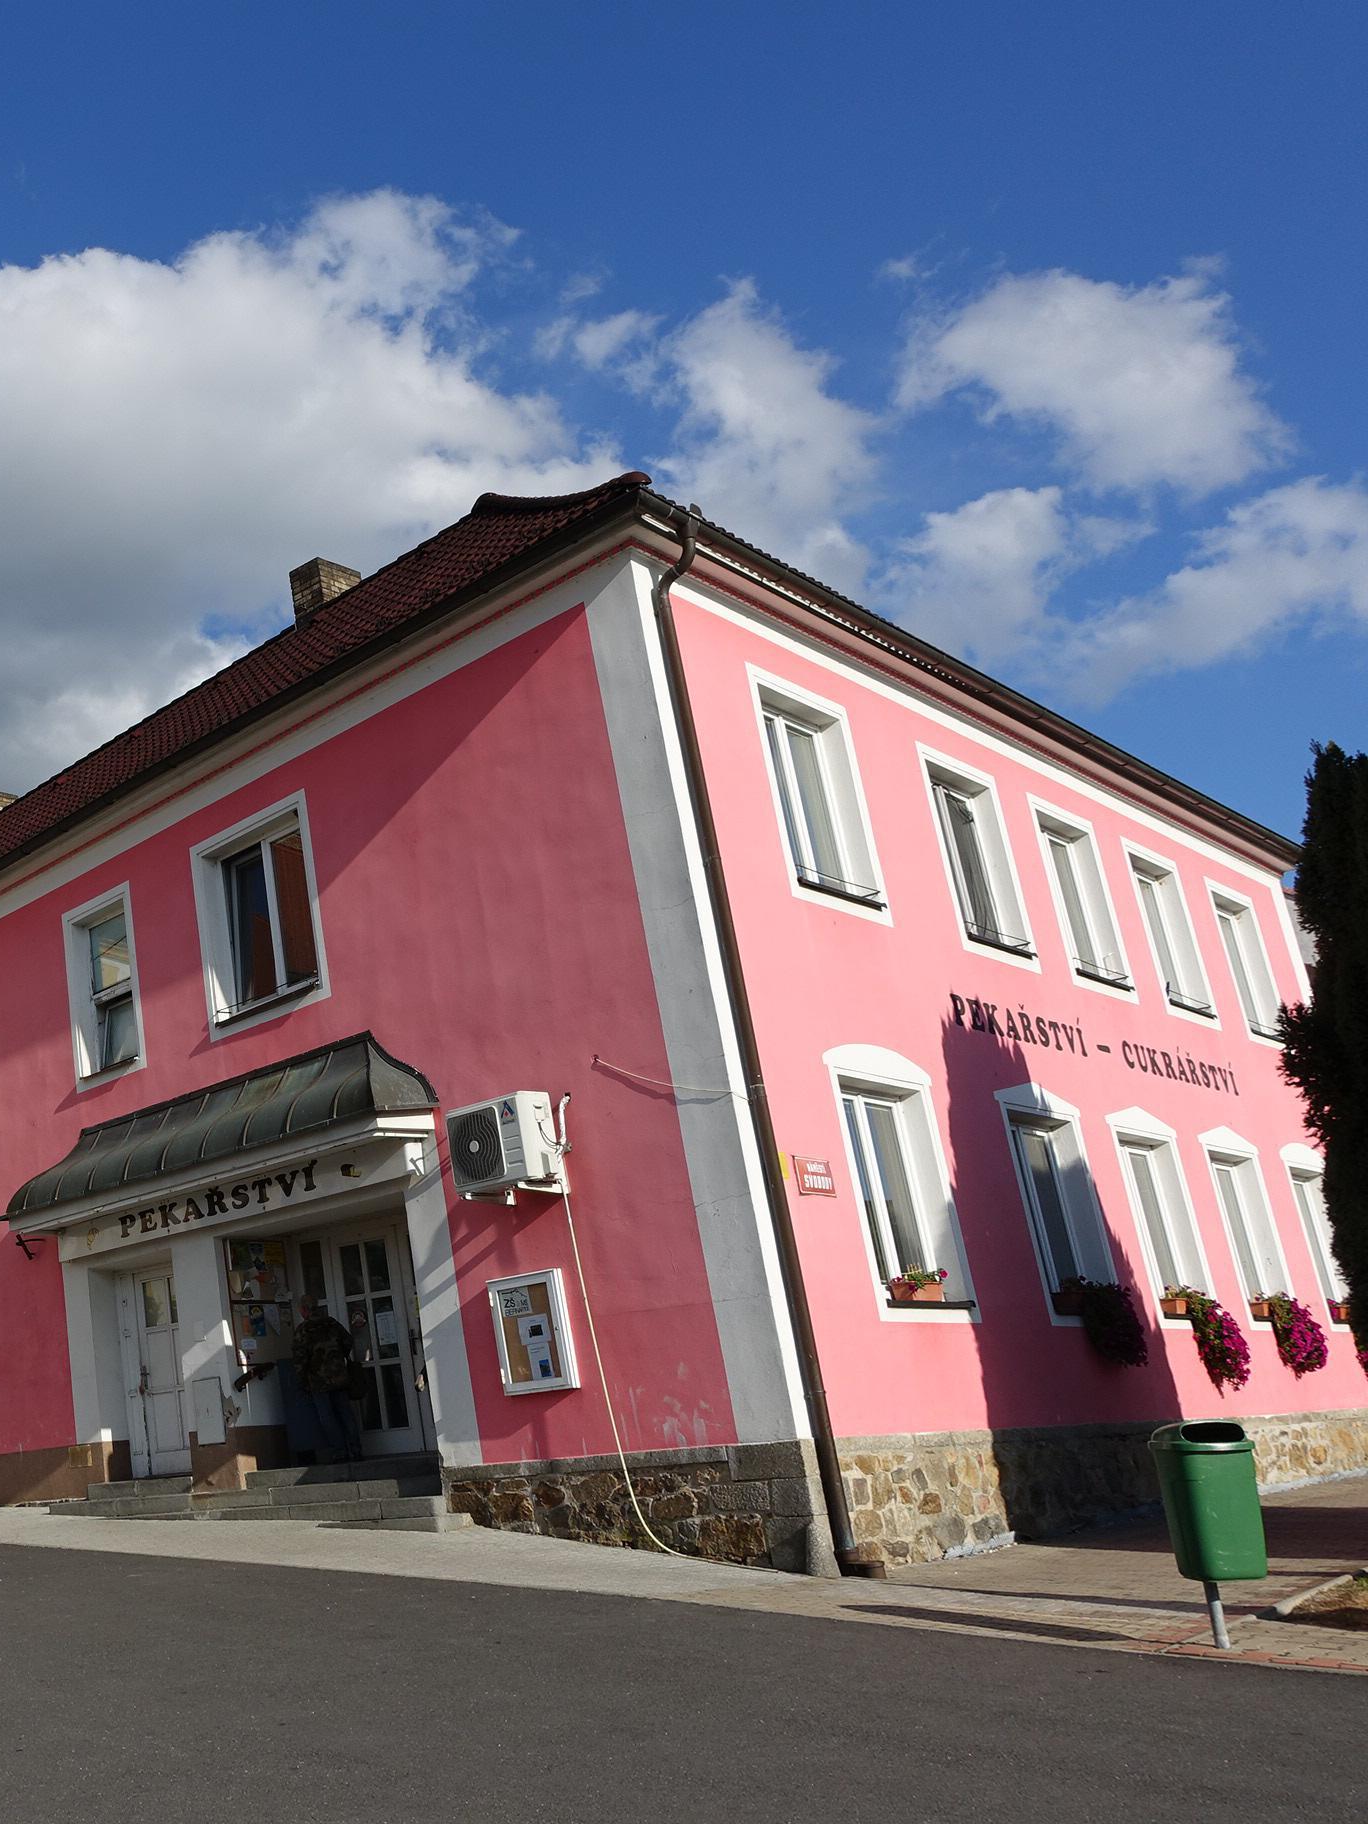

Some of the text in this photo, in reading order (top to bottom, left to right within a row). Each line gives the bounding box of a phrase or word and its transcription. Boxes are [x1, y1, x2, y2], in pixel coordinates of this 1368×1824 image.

[949, 993, 1088, 1057] PEKAŘSTVÍ
[1122, 1040, 1239, 1096] CUKRÁŘSTVÍ
[118, 1160, 318, 1239] PEKAŘSTVÍ
